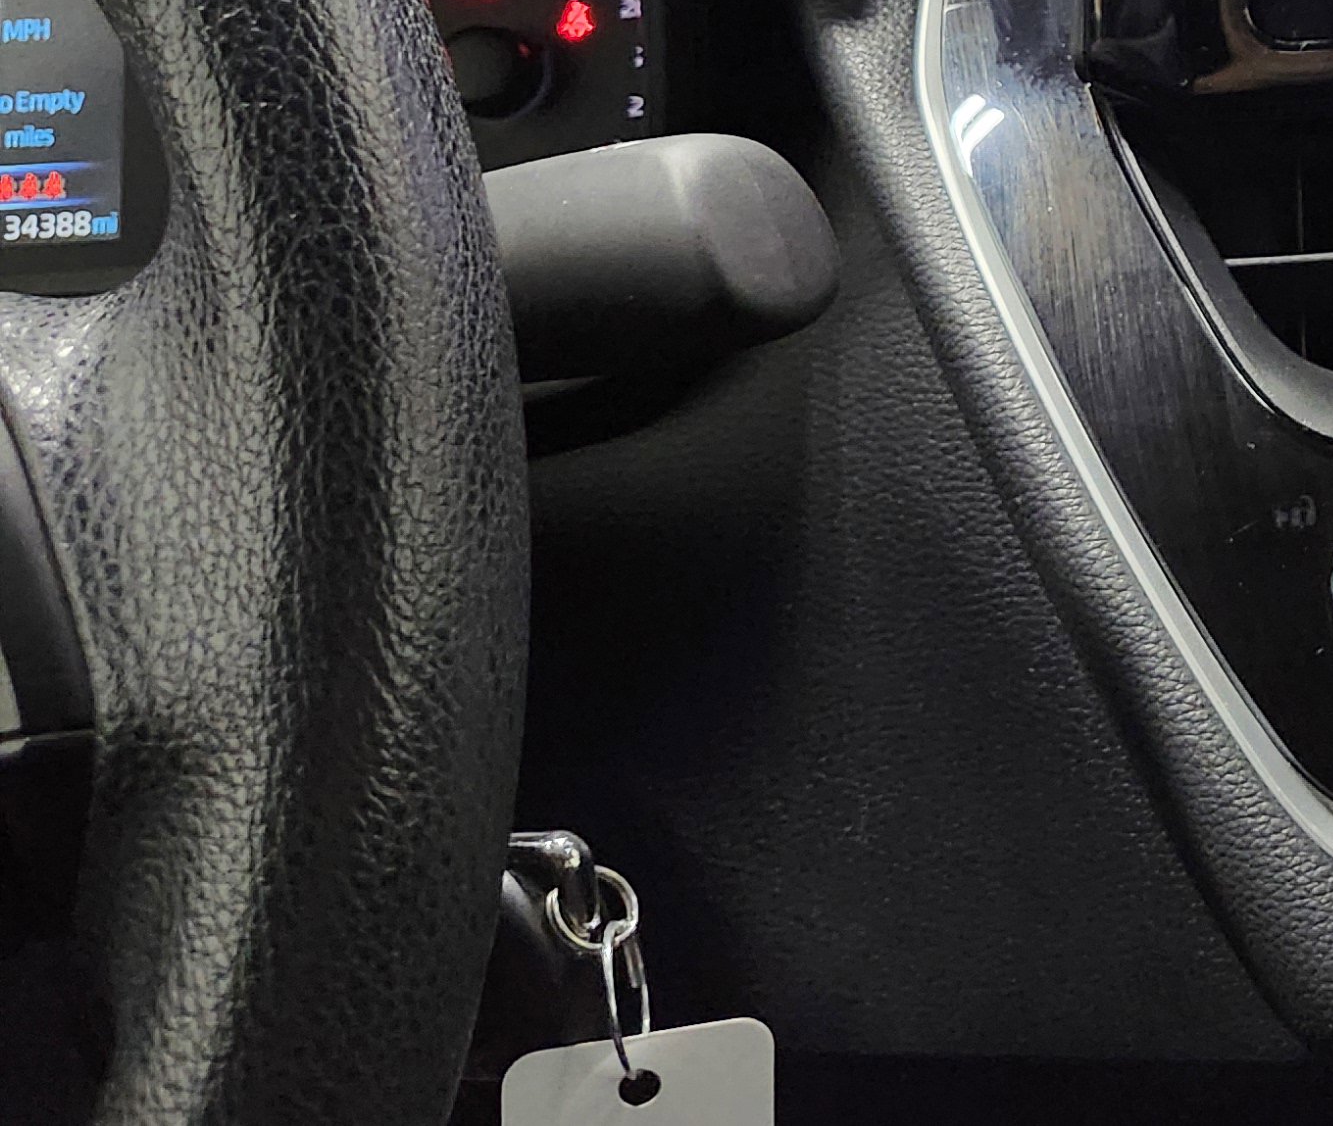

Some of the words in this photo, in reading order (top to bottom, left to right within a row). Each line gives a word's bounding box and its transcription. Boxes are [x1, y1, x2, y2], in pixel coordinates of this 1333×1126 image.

[2, 17, 51, 43] MPH
[15, 88, 86, 115] Empty
[4, 124, 55, 149] miles
